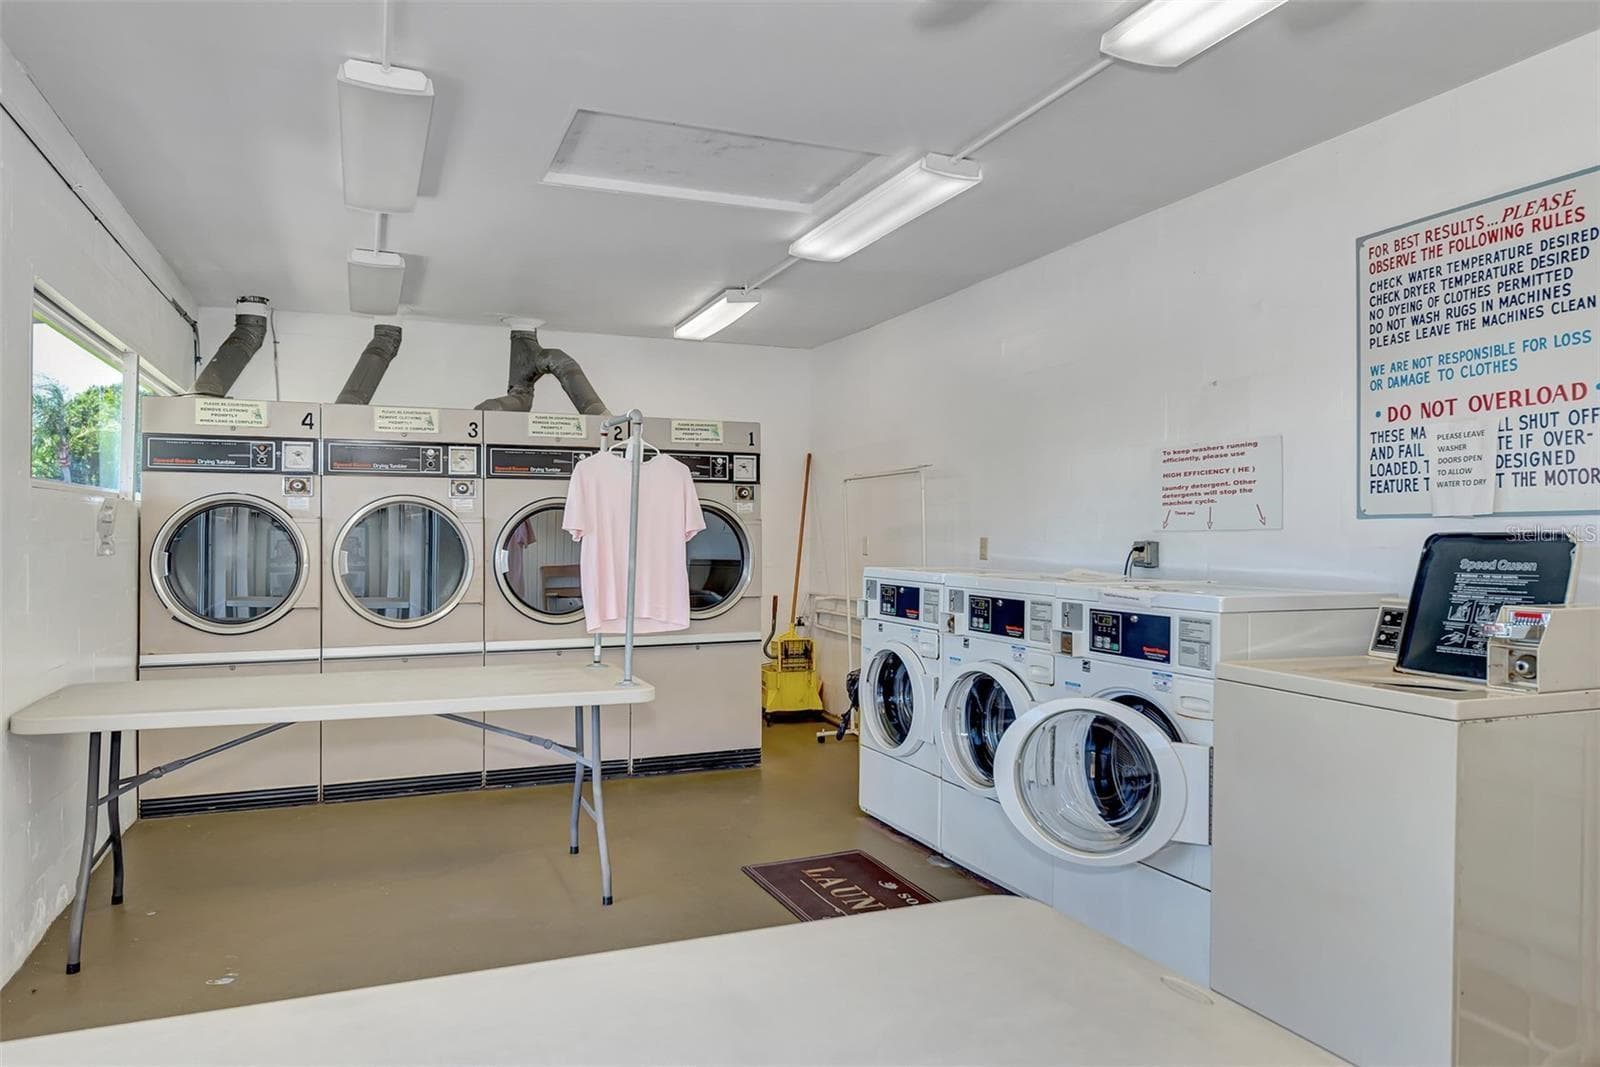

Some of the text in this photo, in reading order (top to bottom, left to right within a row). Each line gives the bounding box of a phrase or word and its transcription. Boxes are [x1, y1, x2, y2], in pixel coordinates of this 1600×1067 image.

[1368, 242, 1389, 259] FOR
[1394, 234, 1420, 251] BEST
[1502, 190, 1576, 223] PLEASE
[1369, 207, 1585, 275] OBSERVE THE FOLLOWING RULES
[1370, 227, 1599, 293] CHECK WATER TEMPERATURE DESIRED
[1370, 246, 1589, 307] CHECK DRYER TEMPERATURE DESIRED
[1370, 267, 1573, 320] NO DYEING OF CLOTHES PERMITTED
[1370, 283, 1571, 335] DO NOT WASH RUGS IN MACHINES
[1370, 296, 1596, 348] PLEASE LEAVE THE MACHINES CLEAN
[1370, 330, 1592, 376] WE ARE NOT RESPONSIBLE FOR LOSS
[1370, 358, 1518, 391] OR DAMAGE TO CLOTHES
[1387, 382, 1588, 422] DO NOT OVERLOAD
[301, 412, 314, 429] 4
[468, 422, 478, 438] 3
[614, 426, 622, 440] 2
[1370, 429, 1404, 444] THESE
[1519, 411, 1559, 431] SHUT
[1568, 407, 1600, 425] OFF
[1437, 432, 1461, 440] PLEASE
[749, 432, 754, 446] 1
[1370, 446, 1394, 460] AND
[1398, 444, 1424, 458] FAIL
[1520, 433, 1533, 448] IF
[1544, 429, 1593, 446] OVER-
[1184, 468, 1230, 477] EFFICIENCY
[1370, 462, 1420, 477] LOADED.
[1496, 450, 1575, 468] DESIGNED
[1438, 456, 1461, 464] DOORS
[1370, 478, 1419, 494] FEATURE
[1512, 471, 1537, 487] THE
[1544, 468, 1600, 486] MOTOR
[1460, 559, 1537, 571] Speed Queen
[801, 867, 888, 909] LAUN
